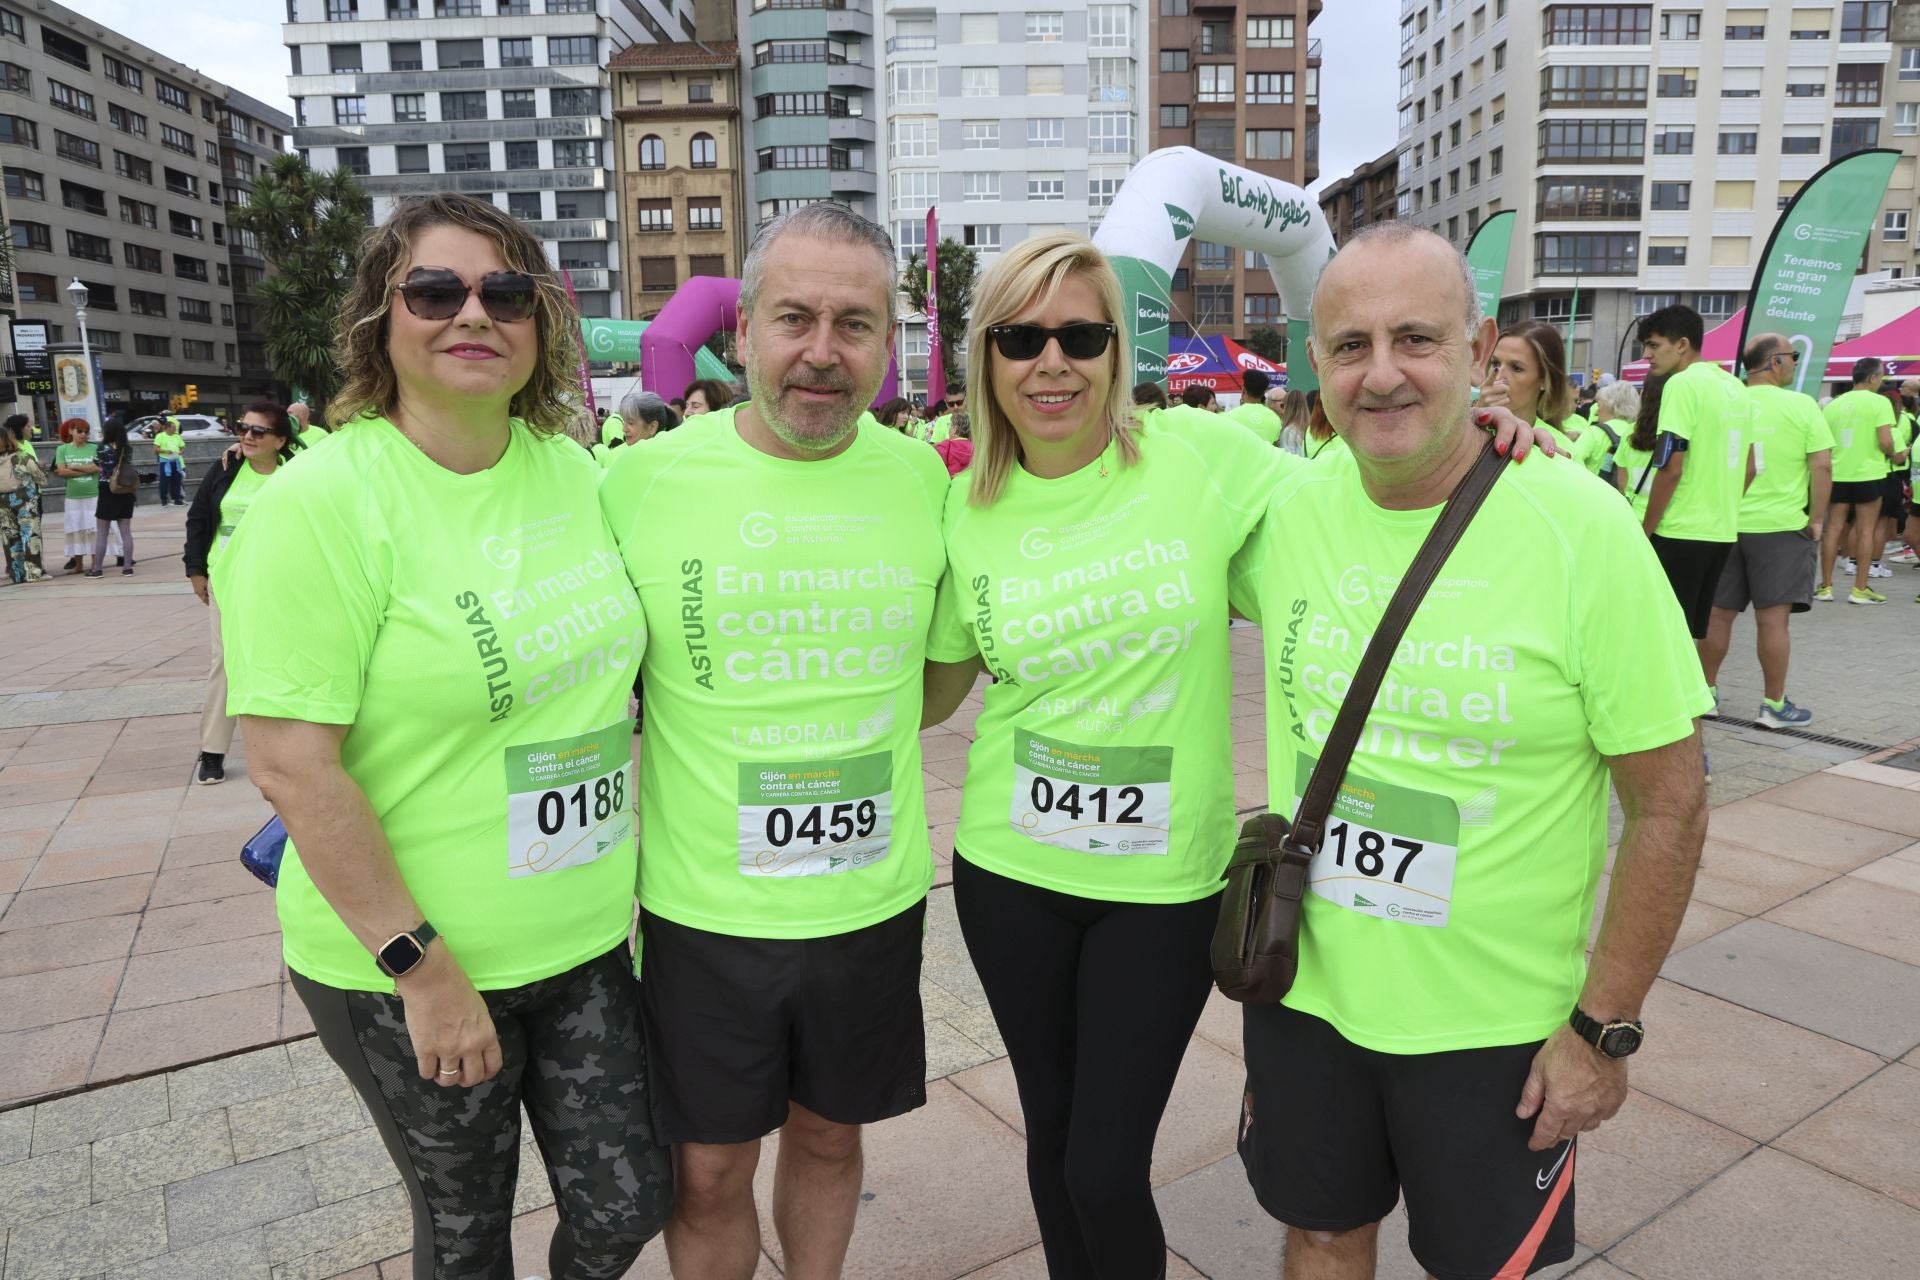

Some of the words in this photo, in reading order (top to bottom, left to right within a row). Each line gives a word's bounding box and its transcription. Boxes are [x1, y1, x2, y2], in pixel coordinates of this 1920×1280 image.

[1219, 168, 1235, 205] El
[1235, 176, 1268, 214] Corte
[1263, 179, 1311, 232] Inglés
[1778, 269, 1795, 279] un
[1796, 270, 1826, 283] gran
[1783, 253, 1841, 270] Tenemos
[1769, 294, 1791, 305] por
[1773, 280, 1820, 295] camino
[1766, 306, 1815, 321] delante
[26, 381, 51, 390] 10:55
[490, 586, 537, 620] En
[533, 549, 625, 603] march
[716, 565, 764, 595] En
[778, 559, 916, 592] marcha
[1000, 577, 1041, 605] En
[1053, 538, 1190, 592] marcha
[514, 593, 628, 662] contra
[681, 558, 714, 690] ASTURIAS
[717, 600, 873, 636] contra
[881, 594, 915, 630] el
[1001, 588, 1149, 645] contra
[1155, 569, 1196, 609] el
[455, 590, 514, 723] ASTURIAS
[724, 637, 913, 682] cáncer
[1017, 618, 1200, 682] cáncer
[1306, 613, 1349, 653] En
[1361, 634, 1516, 671] archa
[524, 626, 647, 705] cánc
[1301, 663, 1449, 719] cotra
[1460, 682, 1514, 724] el
[732, 722, 851, 746] LABORAL
[1029, 739, 1049, 752] Gijón
[1050, 746, 1063, 755] en
[1063, 750, 1100, 762] marcha
[1305, 707, 1518, 768] cncer
[527, 751, 555, 764] Gijón
[528, 761, 563, 773] contra
[565, 759, 575, 768] el
[575, 752, 600, 766] cáncer
[759, 771, 786, 782] Gijón
[788, 771, 801, 779] en
[803, 768, 840, 778] marcha
[1028, 749, 1054, 764] contra
[1056, 757, 1066, 766] el
[1067, 759, 1101, 771] cáncer
[537, 770, 624, 836] 0188
[759, 781, 792, 790] contra
[795, 780, 806, 789] el
[807, 779, 840, 788] cáncer
[1031, 776, 1144, 824] 0412
[1341, 794, 1375, 810] cáncer
[766, 799, 877, 848] 0459
